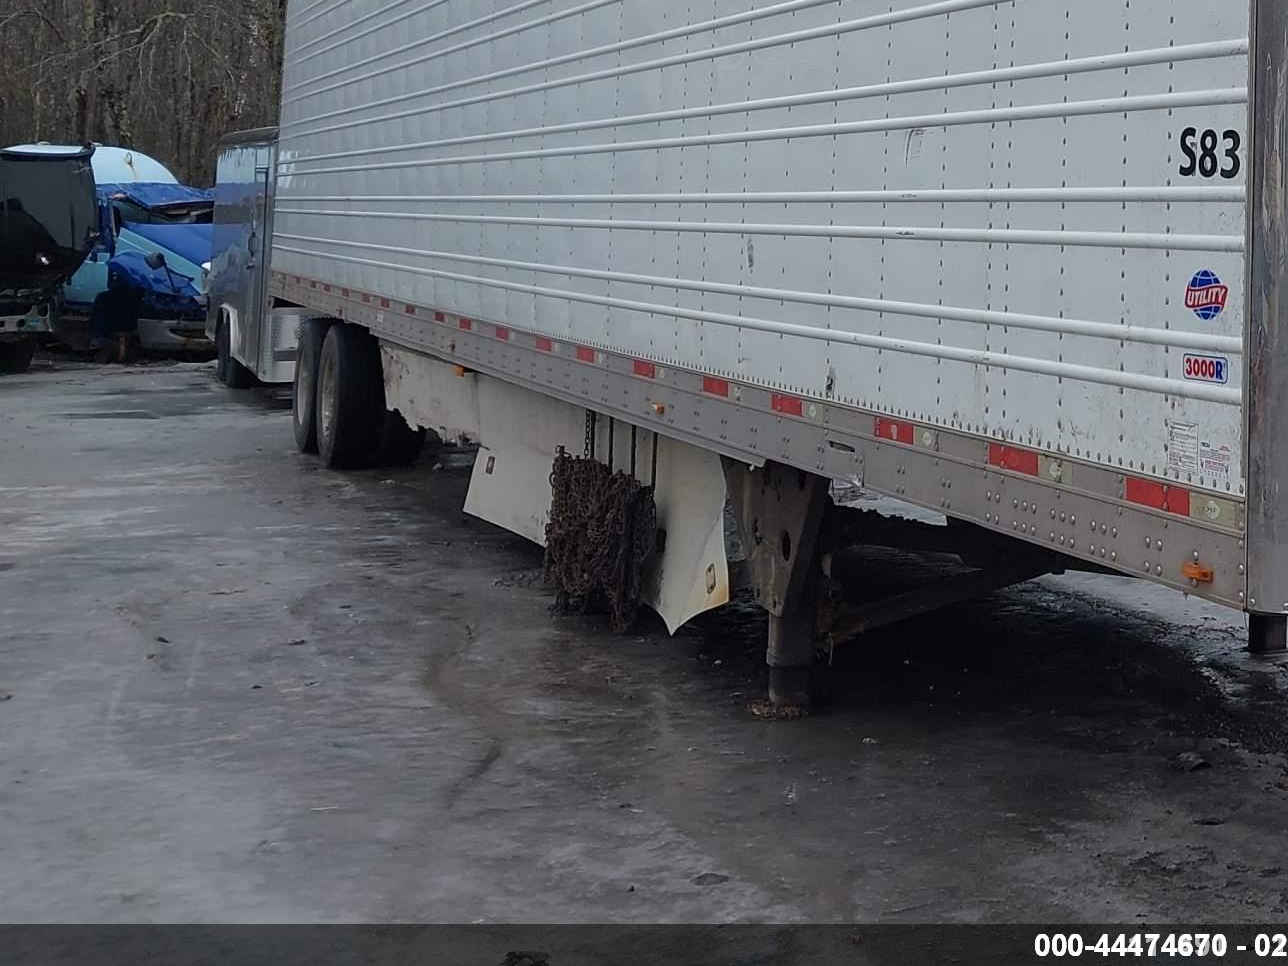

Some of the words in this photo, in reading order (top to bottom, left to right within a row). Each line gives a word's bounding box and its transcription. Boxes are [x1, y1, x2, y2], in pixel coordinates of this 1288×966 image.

[1179, 127, 1241, 179] S83
[1186, 287, 1227, 308] UTILITY
[1185, 357, 1224, 380] 3000R
